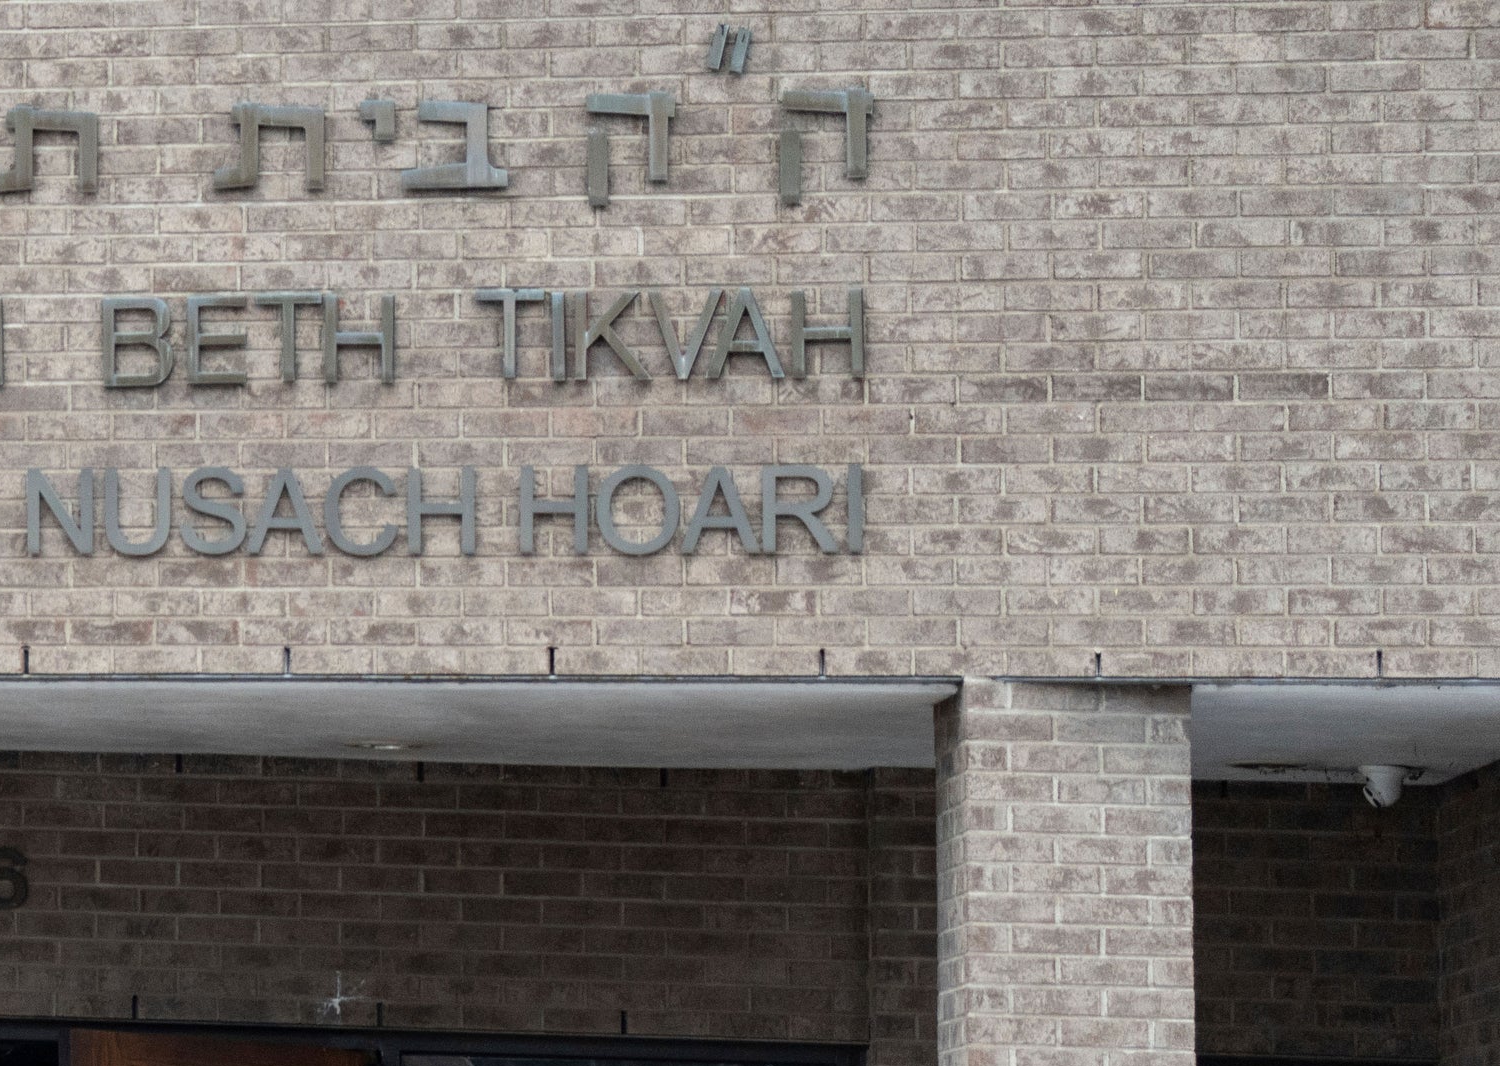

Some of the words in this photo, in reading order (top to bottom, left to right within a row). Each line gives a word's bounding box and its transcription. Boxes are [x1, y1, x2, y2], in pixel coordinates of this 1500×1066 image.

[213, 99, 508, 192] בית
[102, 291, 395, 388] BETH
[476, 286, 864, 384] TIKVAH
[27, 464, 477, 557] NUSACH
[519, 462, 864, 556] HOARI
